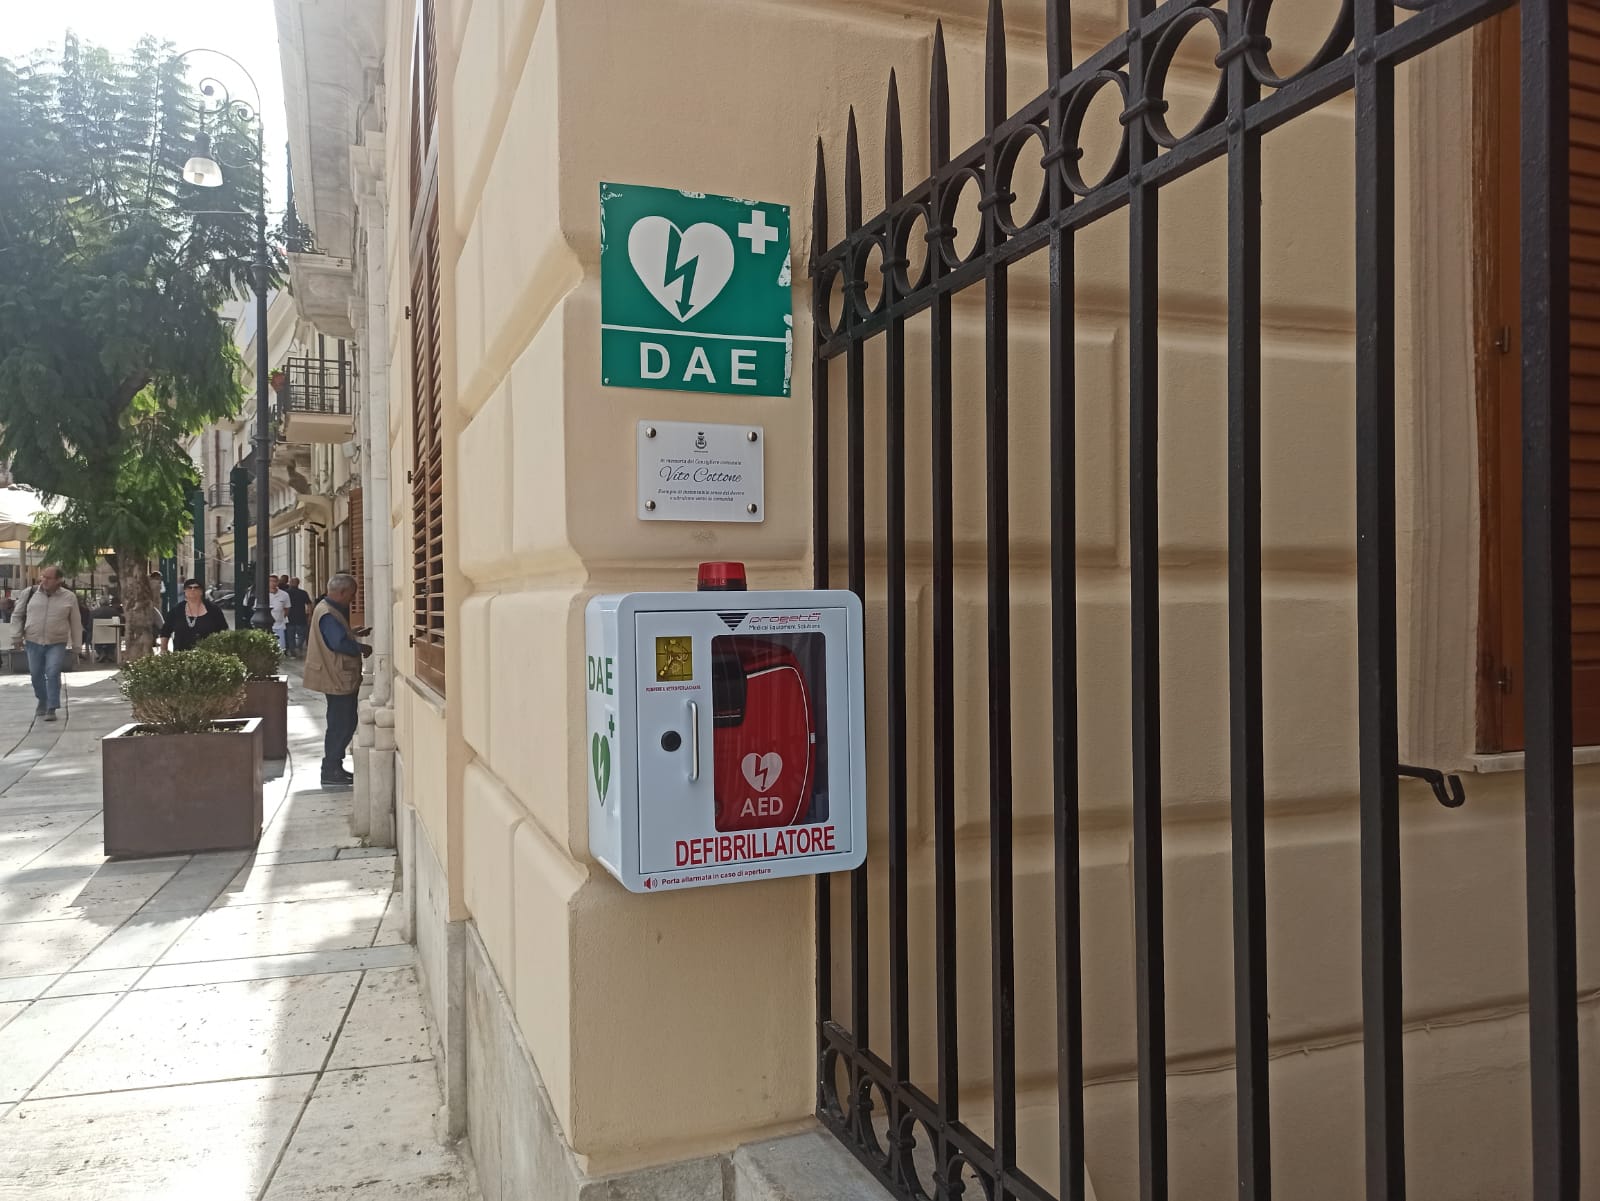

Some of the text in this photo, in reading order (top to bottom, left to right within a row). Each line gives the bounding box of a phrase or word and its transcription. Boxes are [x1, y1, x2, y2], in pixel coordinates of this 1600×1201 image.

[640, 341, 757, 386] DAE
[659, 466, 742, 483] Vito Cottone
[749, 612, 821, 625] progetti
[588, 655, 614, 695] DAE
[740, 796, 784, 817] AED
[675, 825, 835, 866] DEFIBRILLATORE
[681, 874, 712, 883] allarmata
[744, 867, 771, 878] apertura
